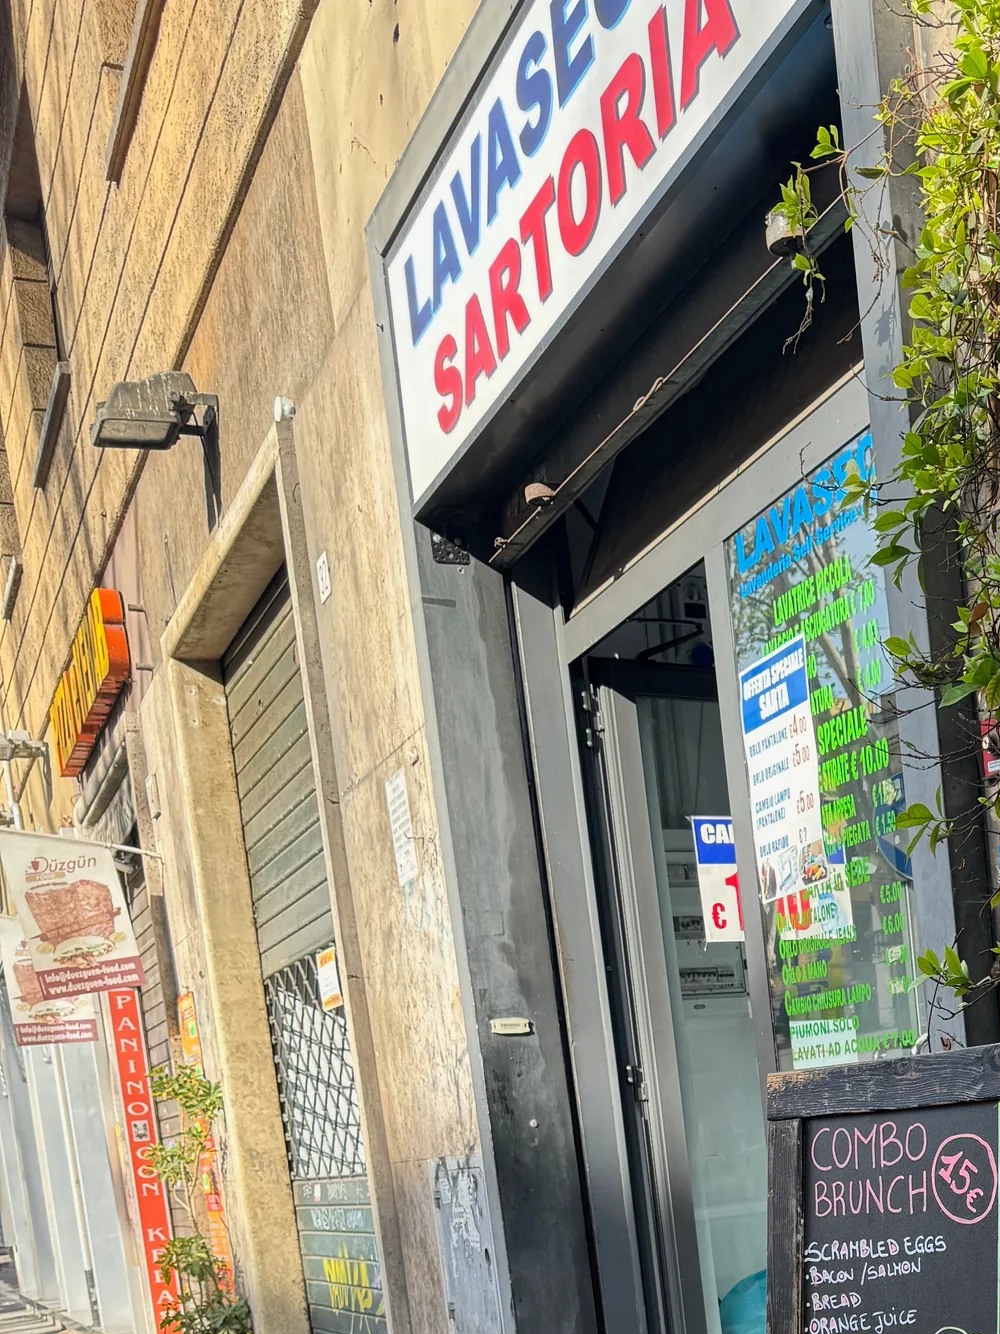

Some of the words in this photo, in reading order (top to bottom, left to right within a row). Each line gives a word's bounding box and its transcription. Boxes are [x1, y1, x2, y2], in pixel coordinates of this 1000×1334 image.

[434, 0, 741, 435] SARTORIA
[740, 553, 792, 598] Lavanderia
[816, 508, 857, 545] Service
[815, 553, 853, 600] PICCOLA
[816, 705, 868, 756] SPECIALE
[851, 750, 859, 780] €
[859, 737, 889, 777] 10.00
[843, 820, 872, 848] PIEGATA
[845, 856, 871, 888] SEDE
[116, 995, 149, 1116] PANINO
[811, 1121, 927, 1171] COMBO
[814, 1171, 927, 1217] BRUNCH
[804, 1239, 900, 1263] SCRAMBLED
[904, 1235, 947, 1254] EGGS
[809, 1265, 854, 1285] BACON
[812, 1292, 862, 1311] BREAD
[872, 1307, 918, 1334] JUICE
